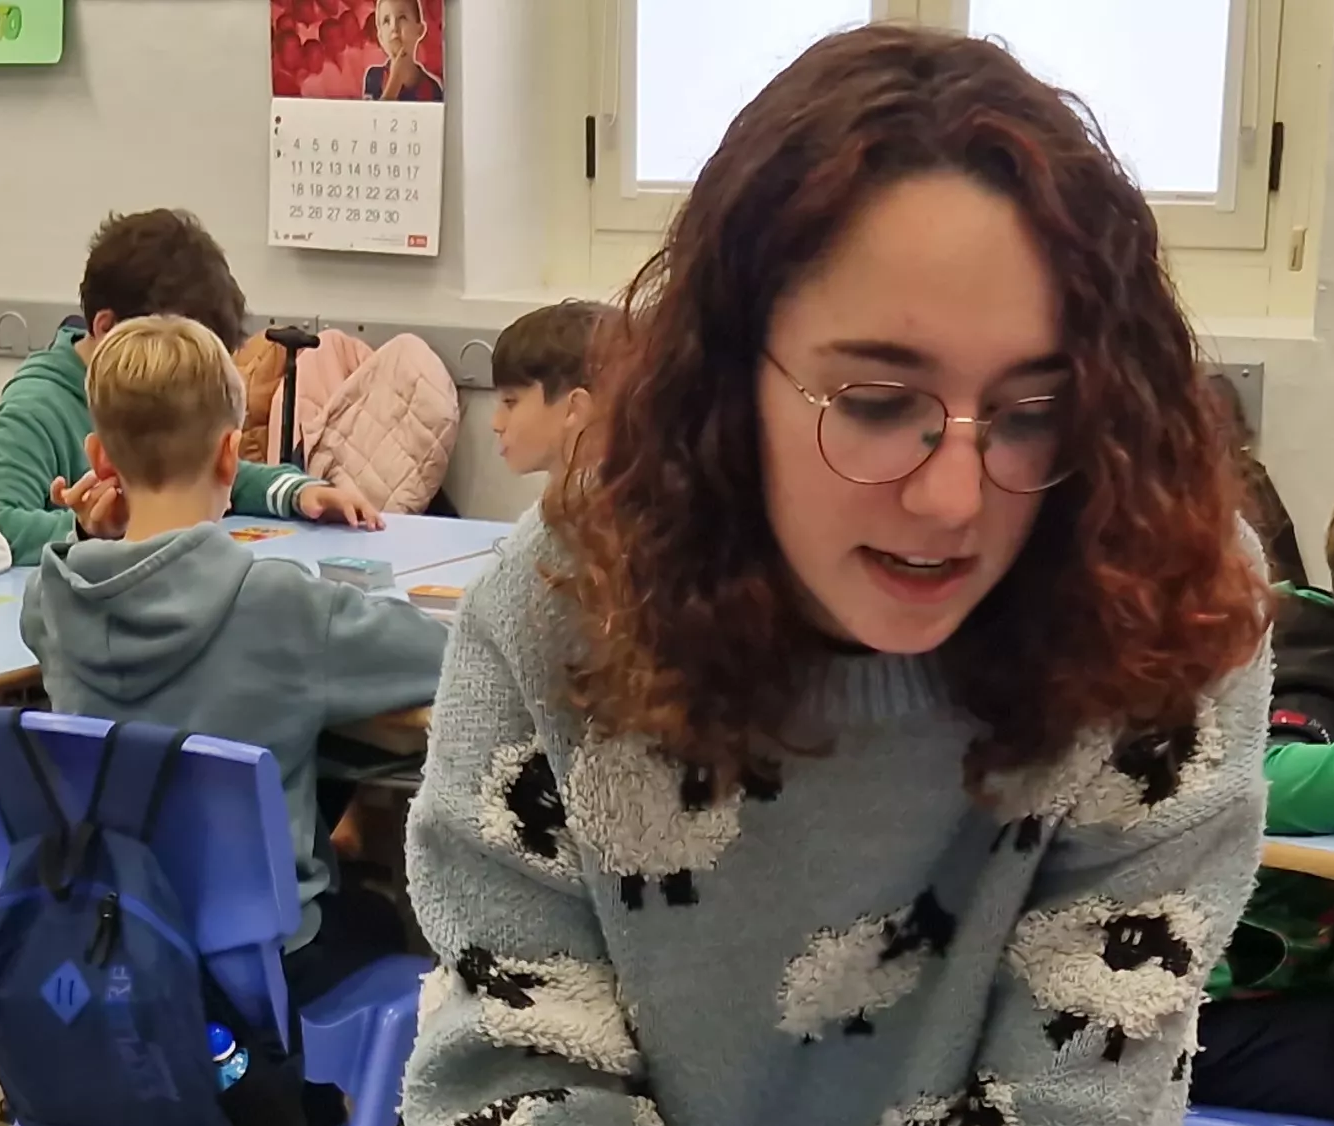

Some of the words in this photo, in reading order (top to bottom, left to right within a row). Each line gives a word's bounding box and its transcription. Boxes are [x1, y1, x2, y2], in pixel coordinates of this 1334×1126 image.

[408, 143, 420, 157] 10
[292, 161, 302, 175] 11
[311, 161, 323, 174] 12
[330, 162, 341, 175] 13
[349, 163, 360, 175] 14
[368, 164, 380, 179] 15
[387, 165, 400, 178] 16
[407, 166, 419, 180] 17
[292, 182, 304, 196] 18
[310, 183, 323, 197] 19
[327, 184, 342, 198] 20
[346, 185, 359, 199] 21
[366, 186, 380, 200] 22
[385, 188, 400, 201] 23
[405, 188, 418, 201] 24
[290, 205, 304, 218] 25
[308, 206, 322, 219] 26
[327, 207, 340, 221] 27
[346, 208, 360, 221] 28
[365, 209, 380, 223] 29
[384, 210, 399, 223] 30
